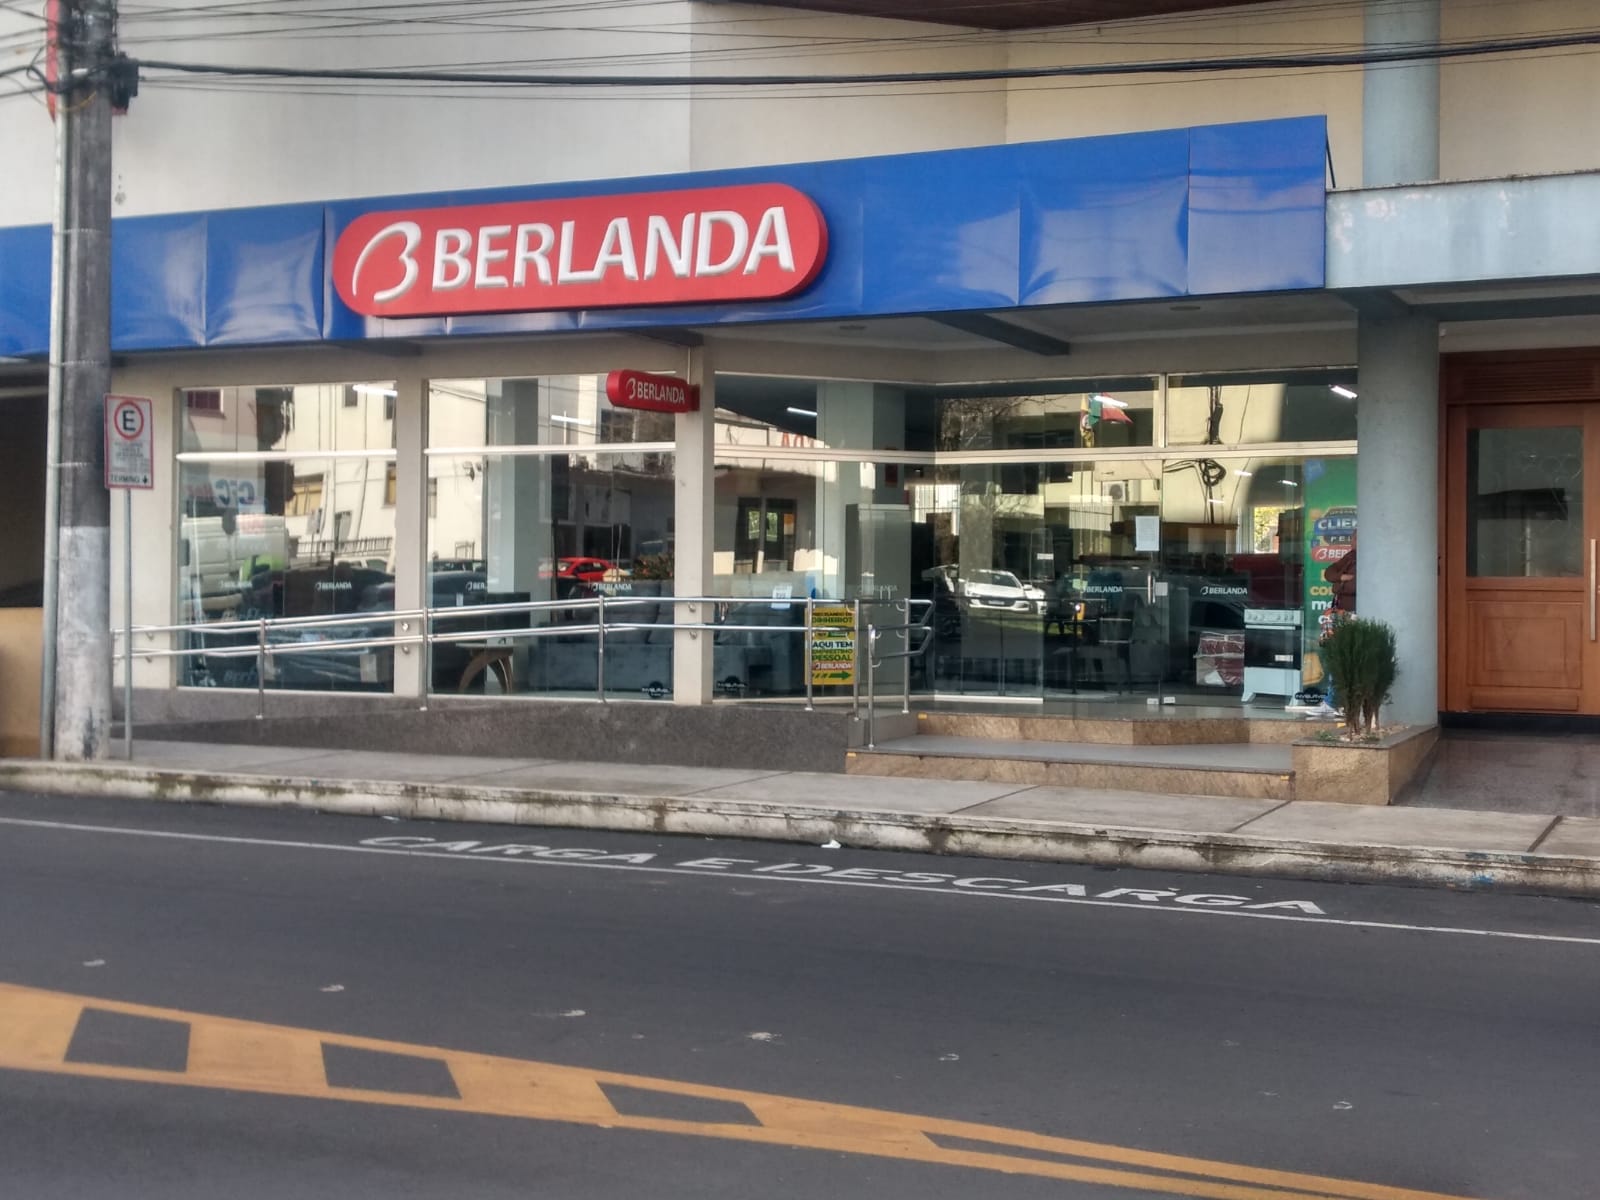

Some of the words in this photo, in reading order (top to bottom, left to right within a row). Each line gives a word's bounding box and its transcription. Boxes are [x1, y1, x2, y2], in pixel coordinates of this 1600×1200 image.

[431, 205, 797, 292] BERLANDA
[637, 383, 686, 405] BERLANDA
[122, 409, 136, 431] E
[1086, 585, 1123, 593] BERLANDA
[1208, 586, 1248, 595] BERLANDA
[812, 641, 834, 649] AQUI
[359, 836, 658, 864] CARGA
[674, 856, 760, 869] E
[752, 862, 1326, 915] DESCARGA
